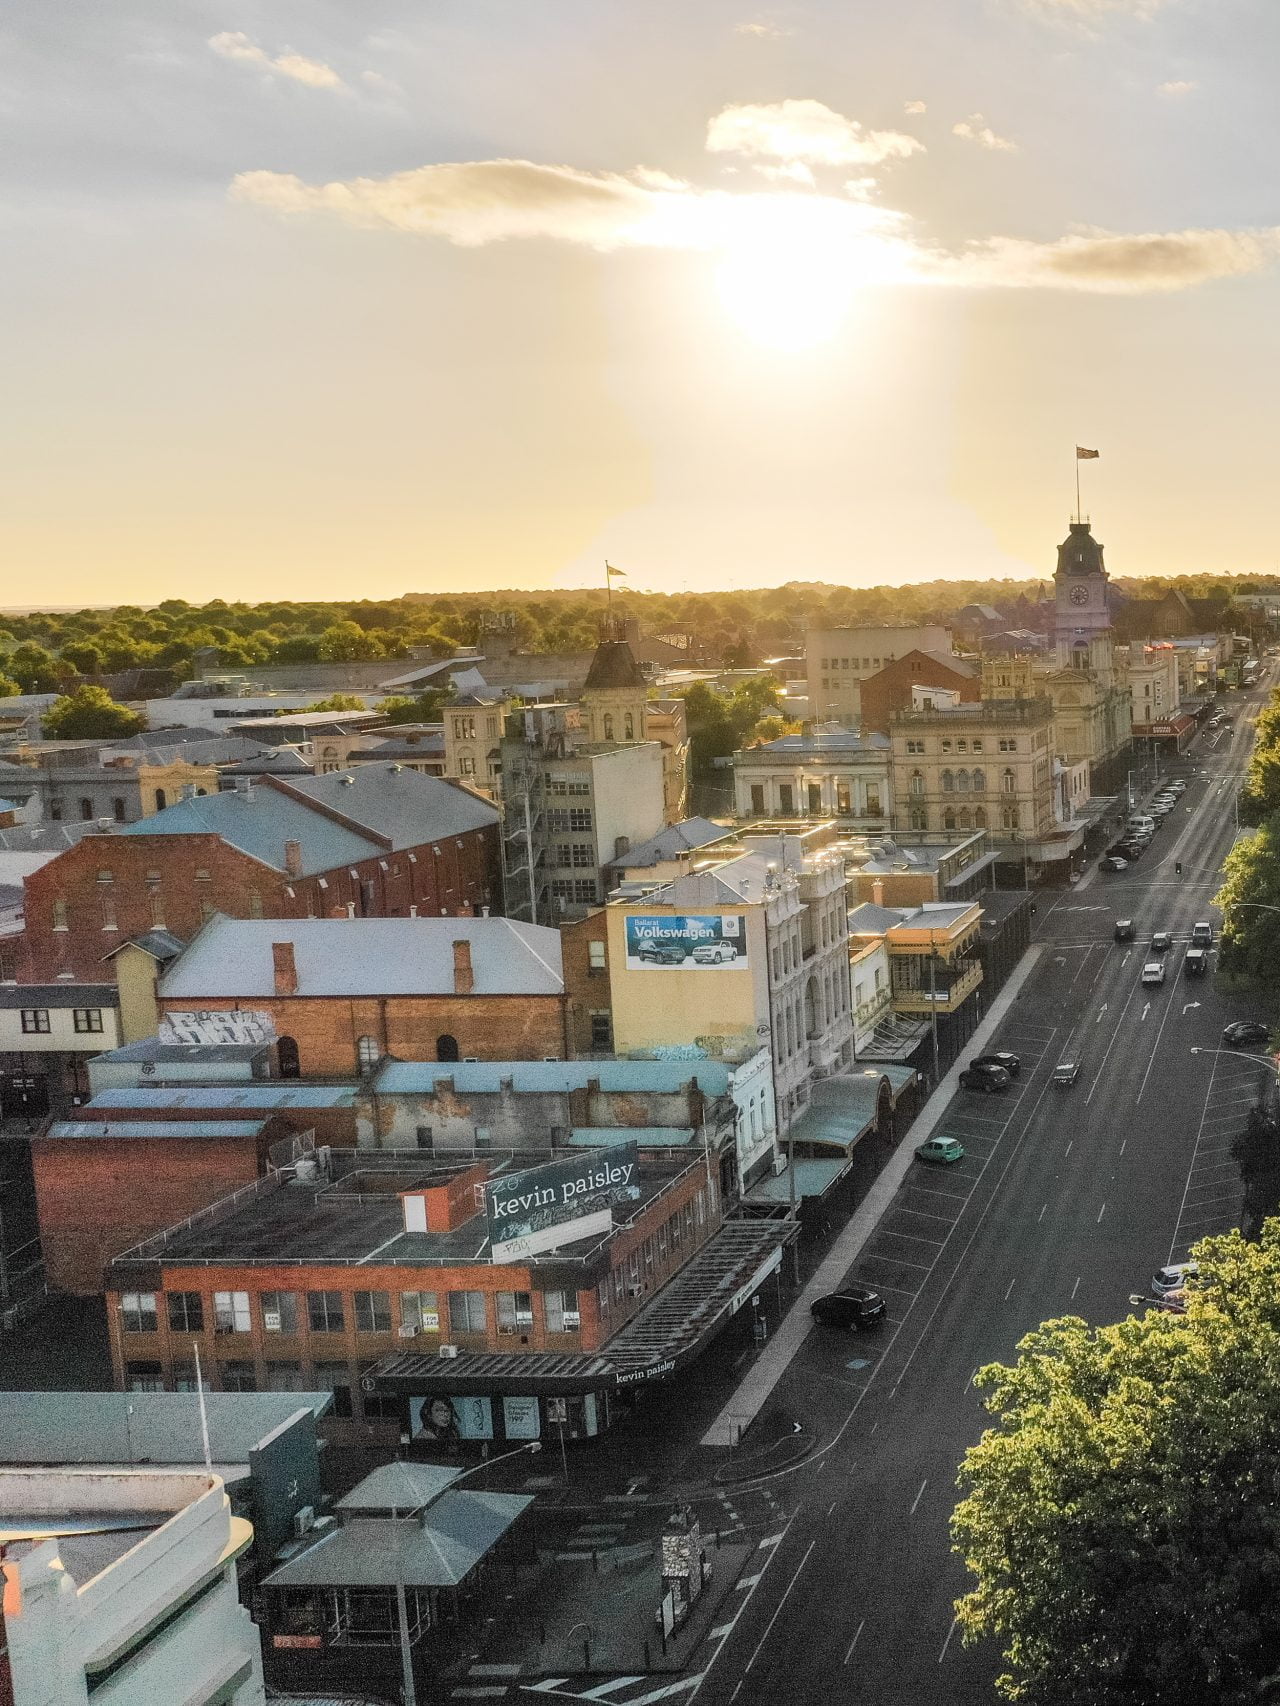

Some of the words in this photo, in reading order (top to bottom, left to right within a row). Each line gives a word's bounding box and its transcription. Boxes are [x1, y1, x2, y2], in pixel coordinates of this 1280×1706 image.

[634, 926, 715, 940] Volkswagen
[492, 1185, 557, 1219] kevin
[562, 1161, 634, 1204] paisley
[616, 1370, 645, 1383] kevin
[647, 1360, 676, 1378] paisley
